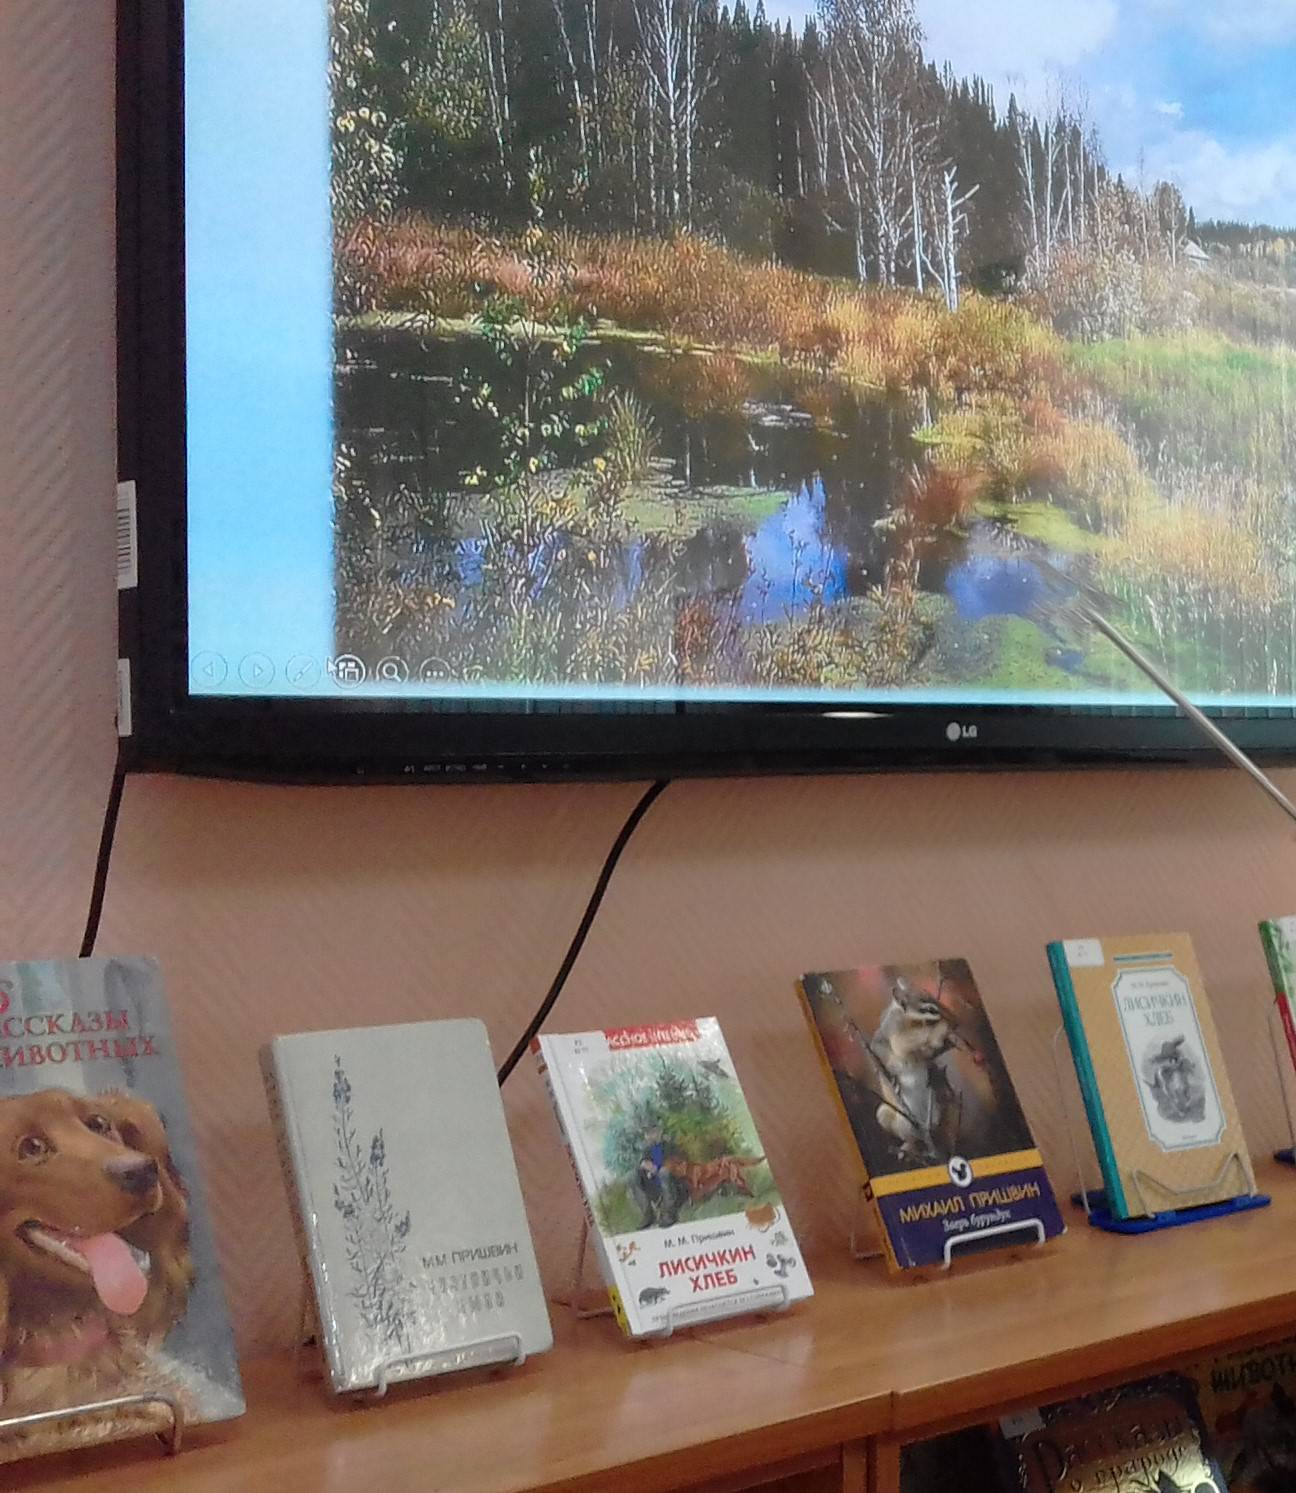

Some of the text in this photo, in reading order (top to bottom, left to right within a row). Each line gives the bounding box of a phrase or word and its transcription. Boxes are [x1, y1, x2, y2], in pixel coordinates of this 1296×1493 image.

[961, 724, 978, 738] LG
[0, 1009, 129, 1038] ССКАЗЫ
[0, 1036, 159, 1068] ИВОТНЫХ
[899, 1181, 1041, 1223] МИХАИЛ ПРИШВИН
[451, 1242, 519, 1264] ПРИШВИН
[658, 1243, 757, 1279] ЛИСИЧКИН
[689, 1268, 738, 1293] ХЛЕБ
